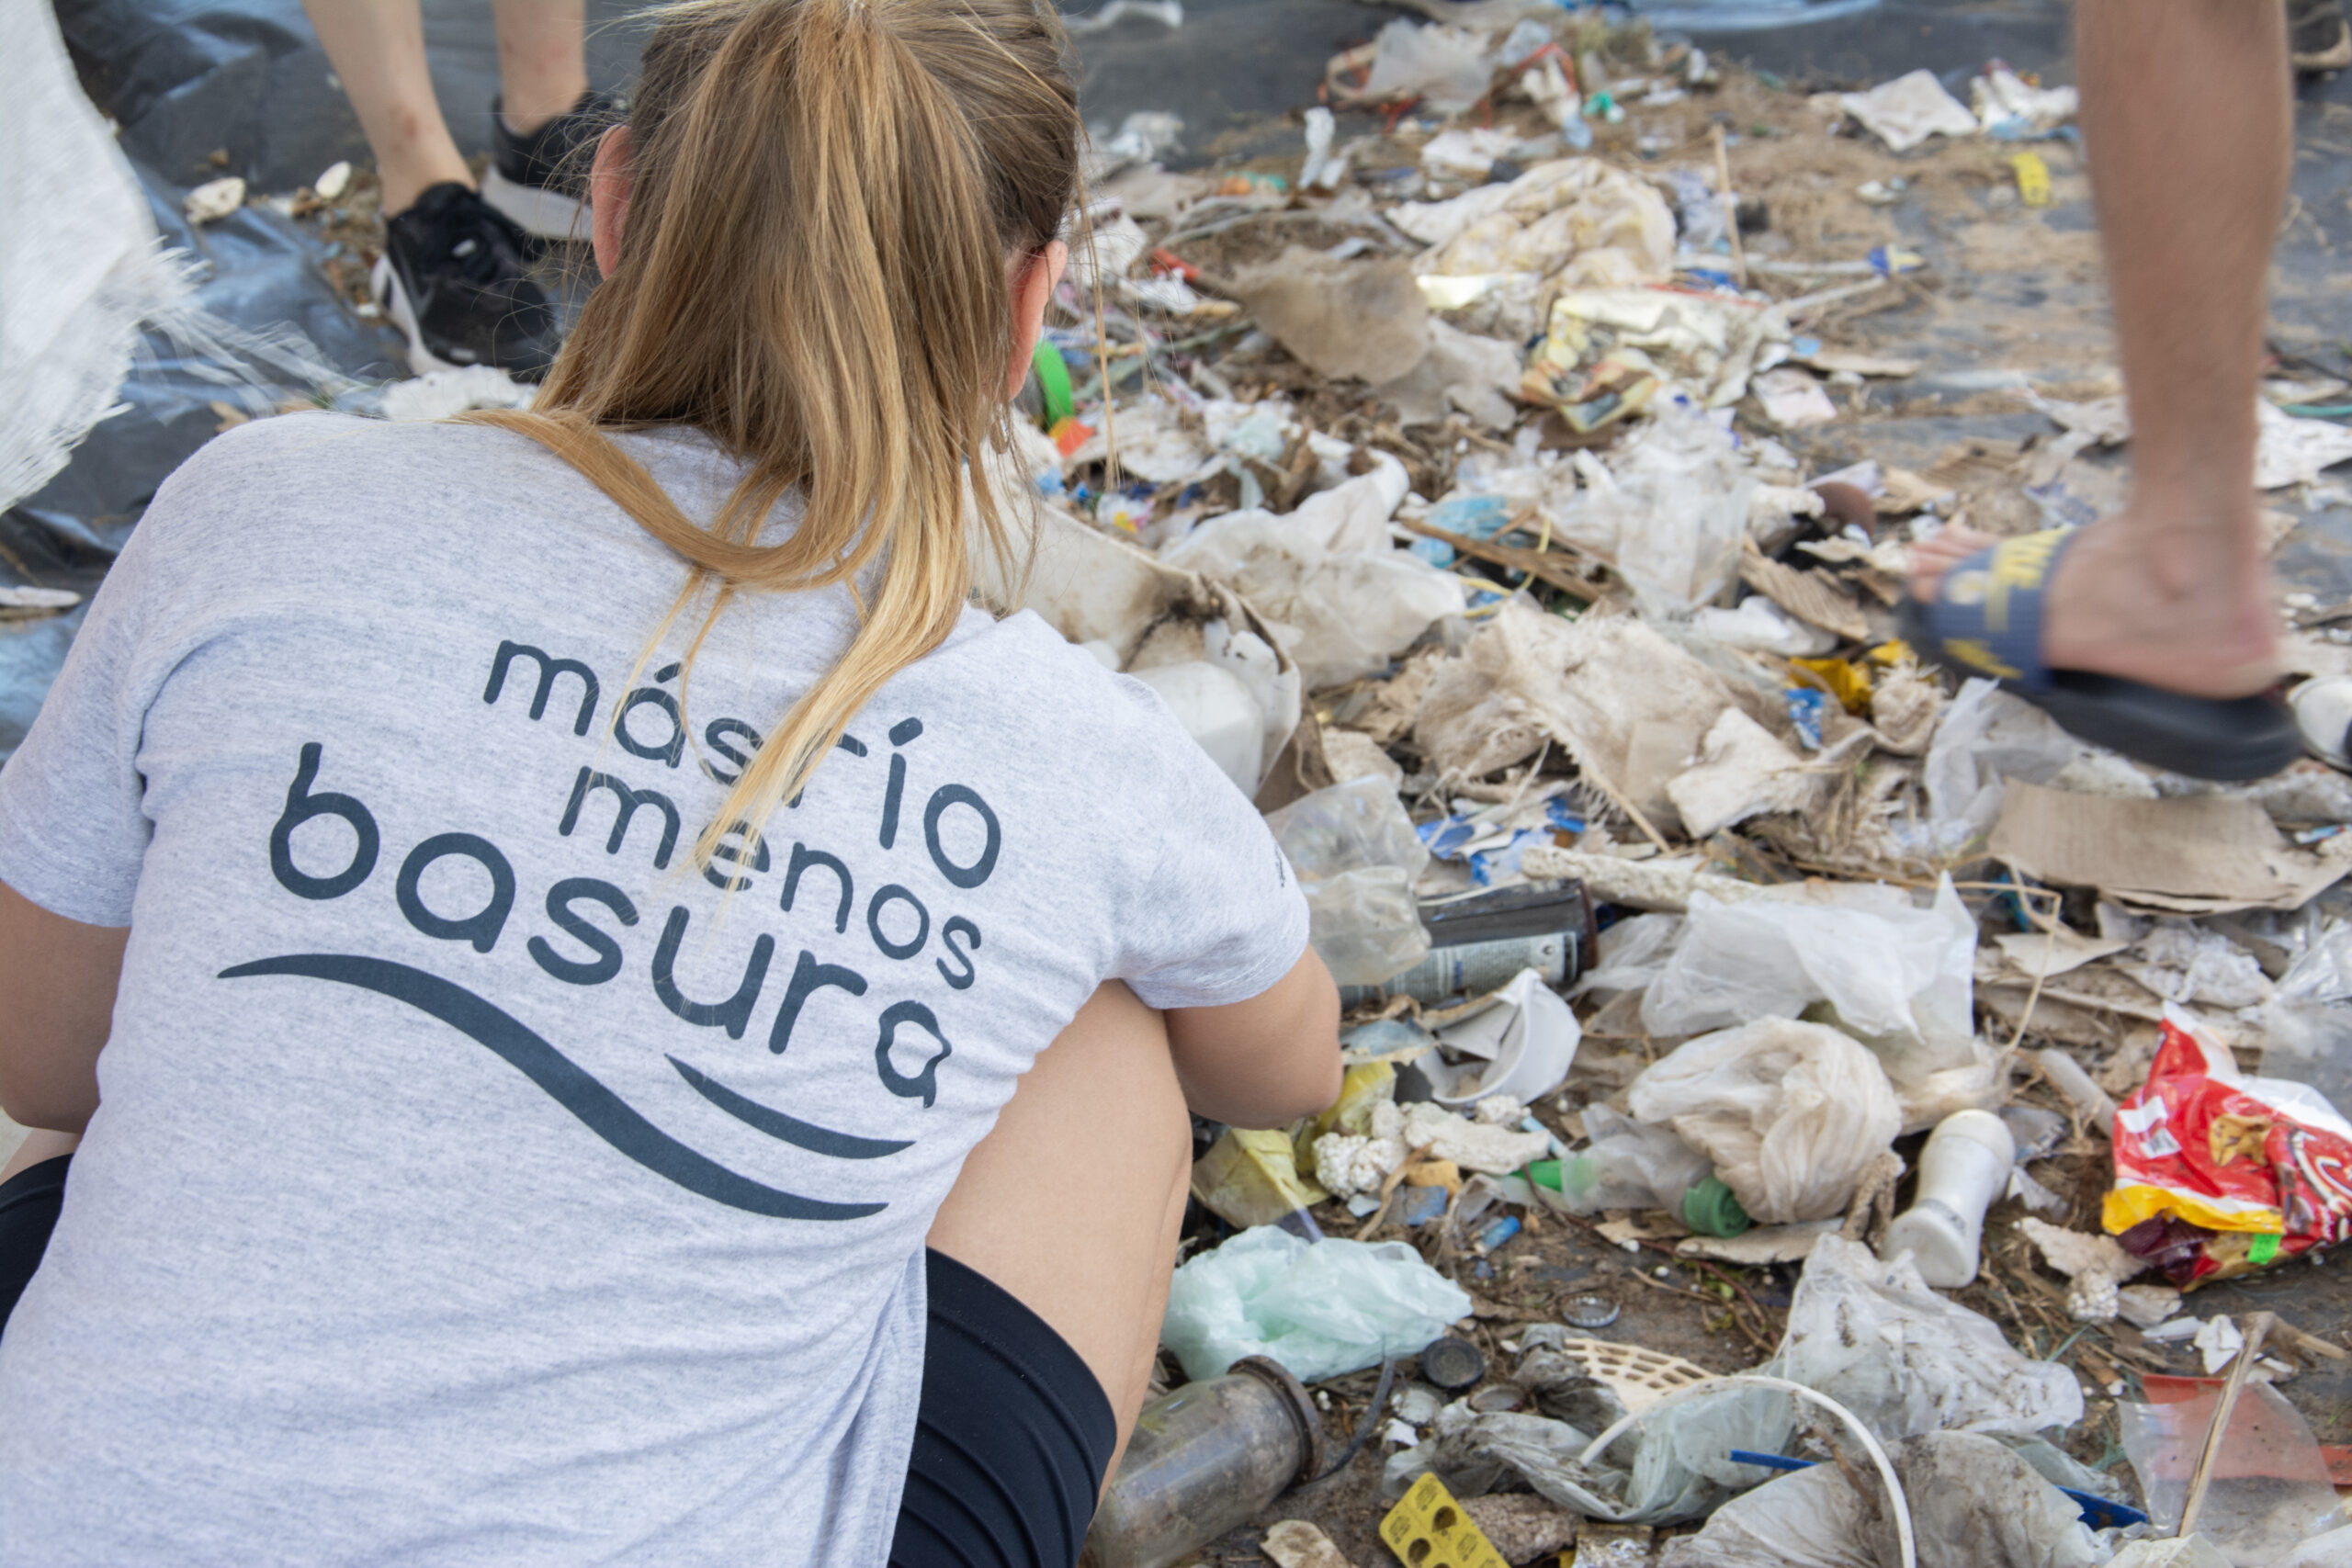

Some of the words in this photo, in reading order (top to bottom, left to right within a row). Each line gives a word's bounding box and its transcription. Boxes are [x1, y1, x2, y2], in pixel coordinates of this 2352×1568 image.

[482, 639, 767, 787] más
[269, 741, 953, 1109] basura
[559, 766, 982, 990] menos
